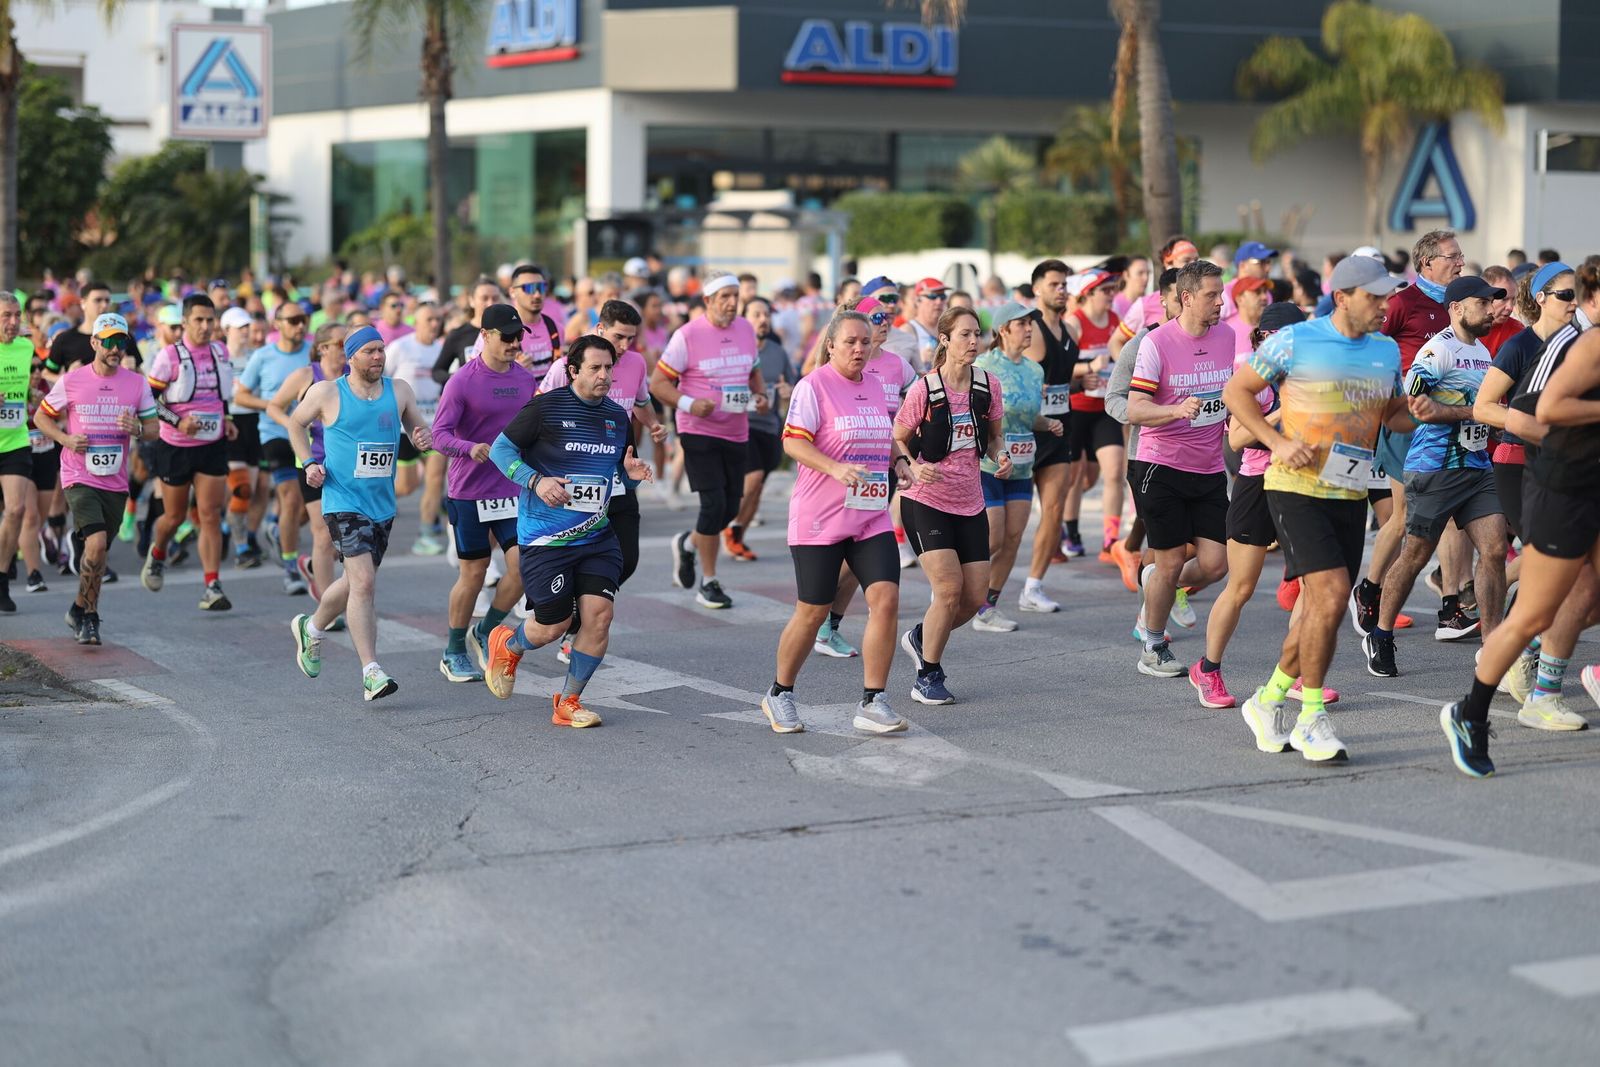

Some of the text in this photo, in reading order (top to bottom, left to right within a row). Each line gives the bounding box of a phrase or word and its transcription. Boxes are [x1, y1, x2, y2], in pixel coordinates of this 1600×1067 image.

[486, 0, 579, 54] ALDI
[784, 18, 958, 75] ALDI
[184, 103, 257, 125] ALDI
[1194, 360, 1215, 371] XXXVI
[1169, 374, 1199, 387] MEDIA
[75, 404, 100, 415] MEDIA
[834, 415, 867, 431] MEDIA
[564, 442, 616, 454] enerplus
[1011, 442, 1033, 454] 622
[92, 454, 117, 466] 637
[360, 452, 394, 467] 1507
[1346, 458, 1359, 475] 7
[572, 485, 601, 501] 541
[850, 482, 887, 498] 1263
[480, 496, 515, 511] 1371
[569, 516, 599, 534] Maratón
